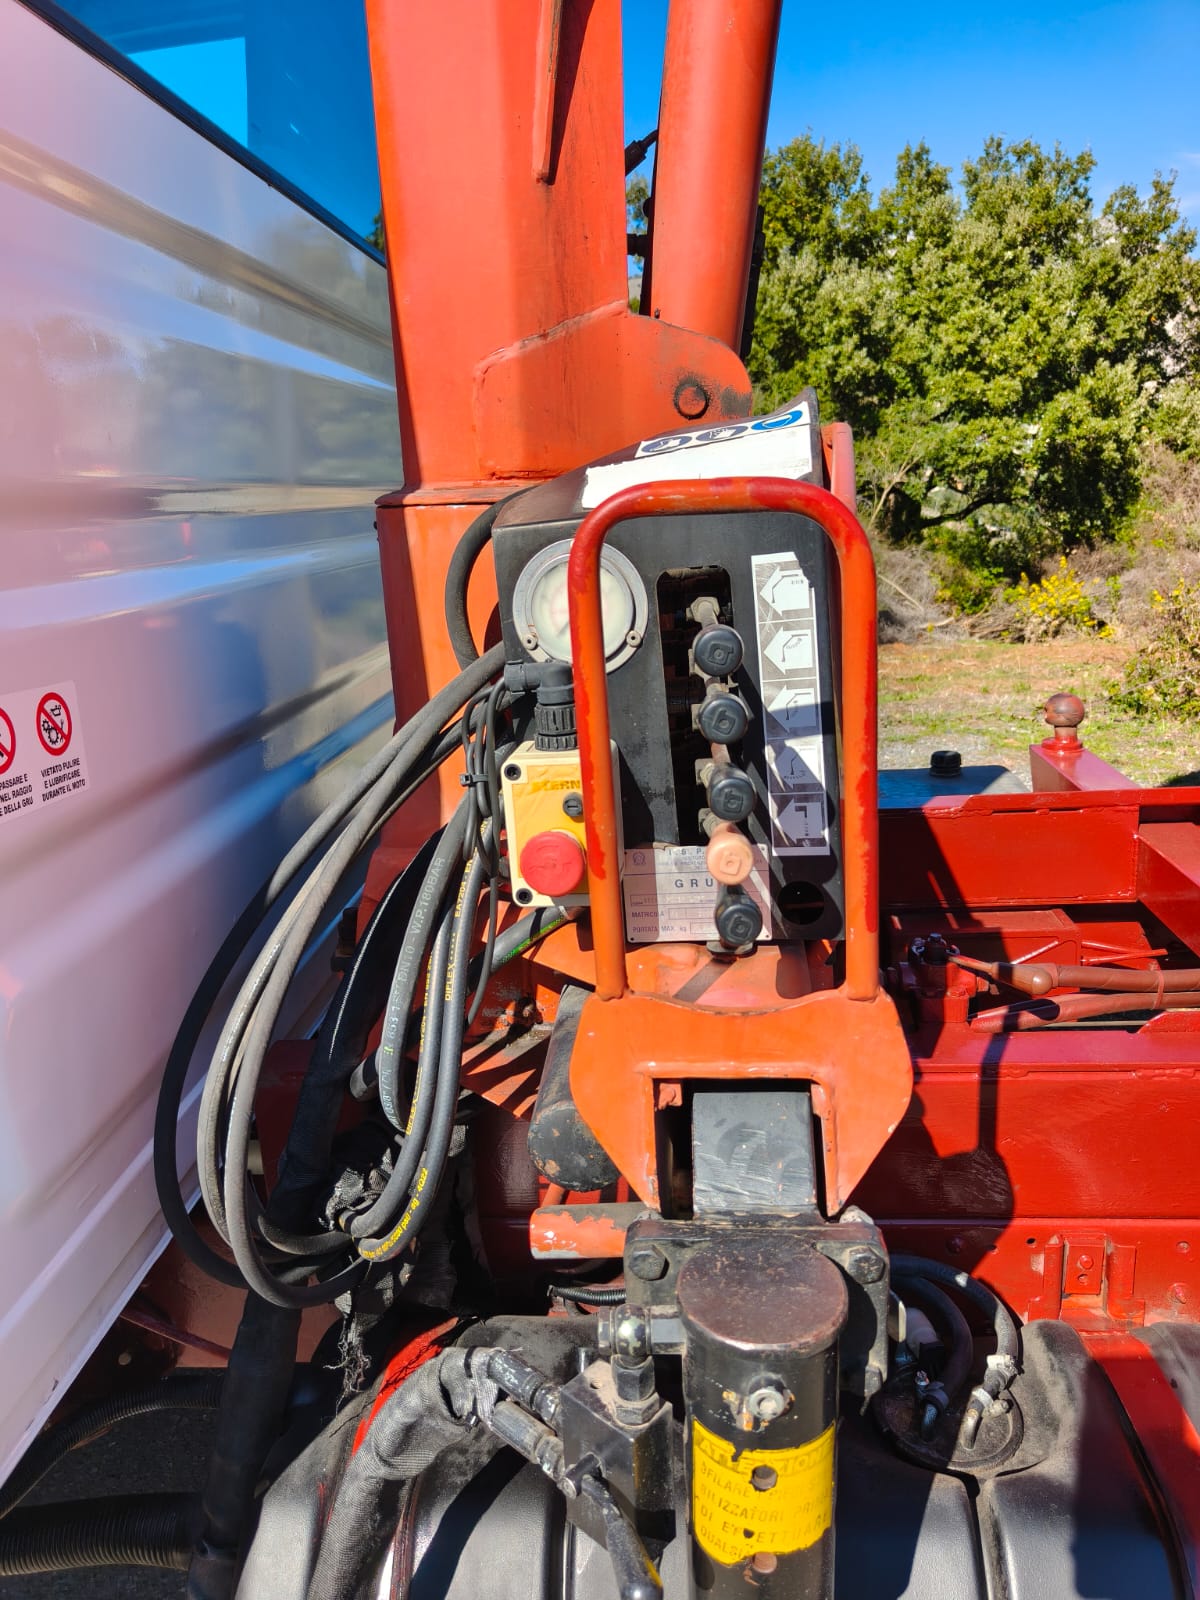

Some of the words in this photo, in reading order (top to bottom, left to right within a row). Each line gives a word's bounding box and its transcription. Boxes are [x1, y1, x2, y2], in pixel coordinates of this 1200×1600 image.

[41, 764, 62, 778] VIETATO
[62, 757, 80, 770] PULIRE
[49, 769, 80, 787] LUBRIFICARE
[0, 791, 12, 803] NEL
[12, 784, 32, 798] RAGGIO
[42, 786, 67, 802] DURANTE
[72, 778, 85, 790] MOTO
[3, 801, 22, 815] DELLA
[22, 796, 33, 807] GRU
[674, 878, 714, 888] GRU
[700, 1504, 713, 1522] DI
